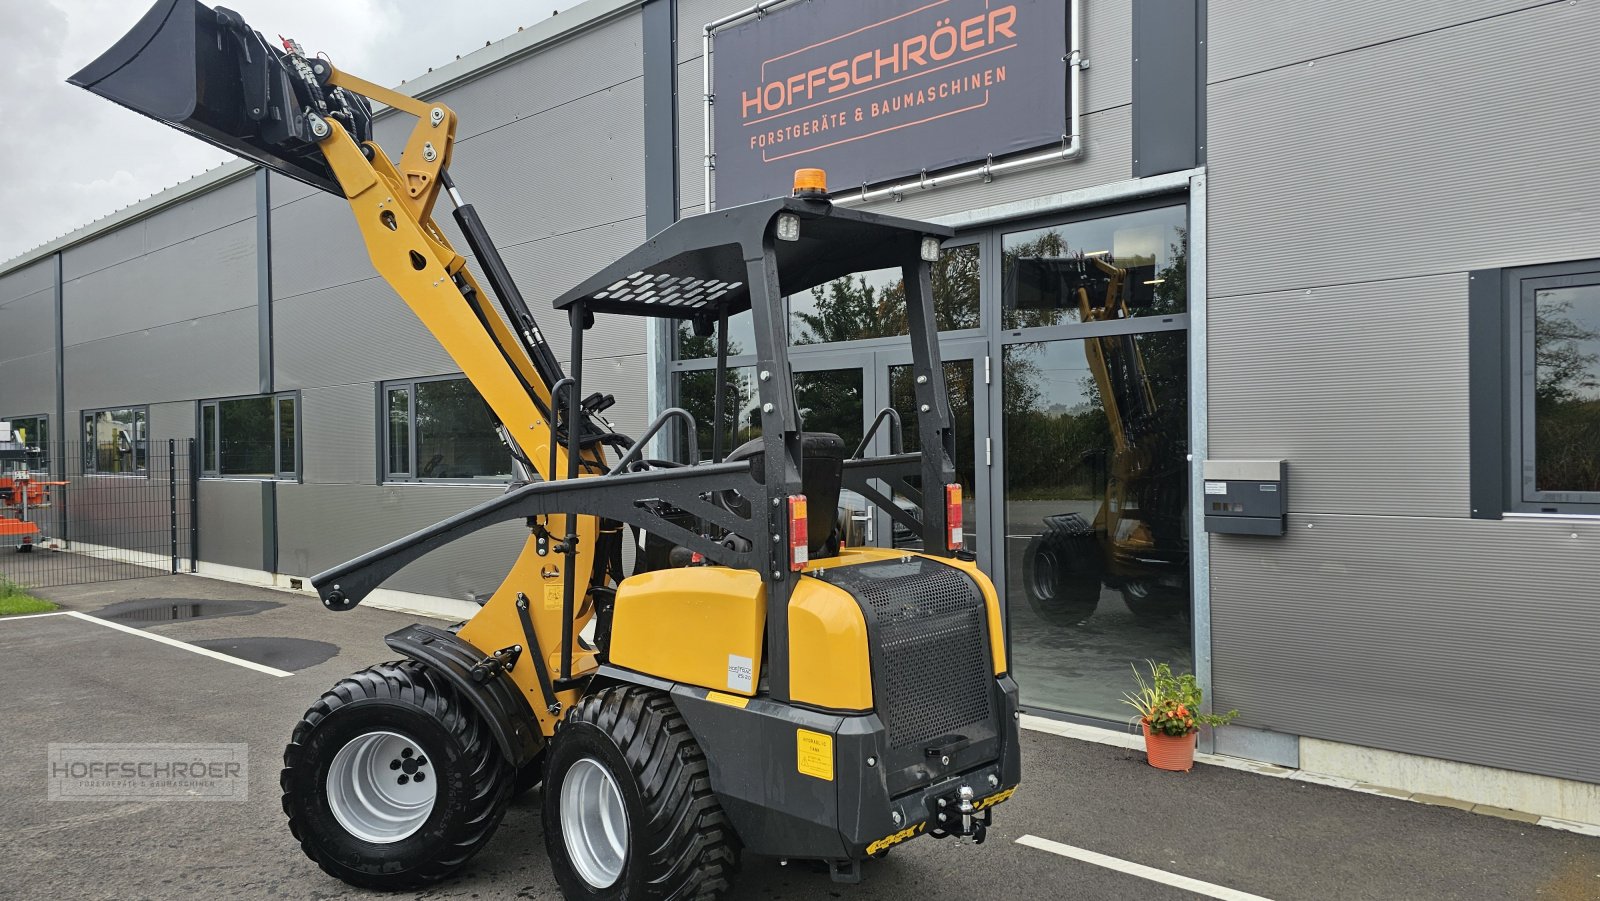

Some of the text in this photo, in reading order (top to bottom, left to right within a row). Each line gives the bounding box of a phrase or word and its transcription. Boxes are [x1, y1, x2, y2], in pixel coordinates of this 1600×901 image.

[742, 5, 1018, 118] HOFFSCHRÖER
[750, 65, 1007, 150] FORSTGERÄTE & BAUMASCHINEN
